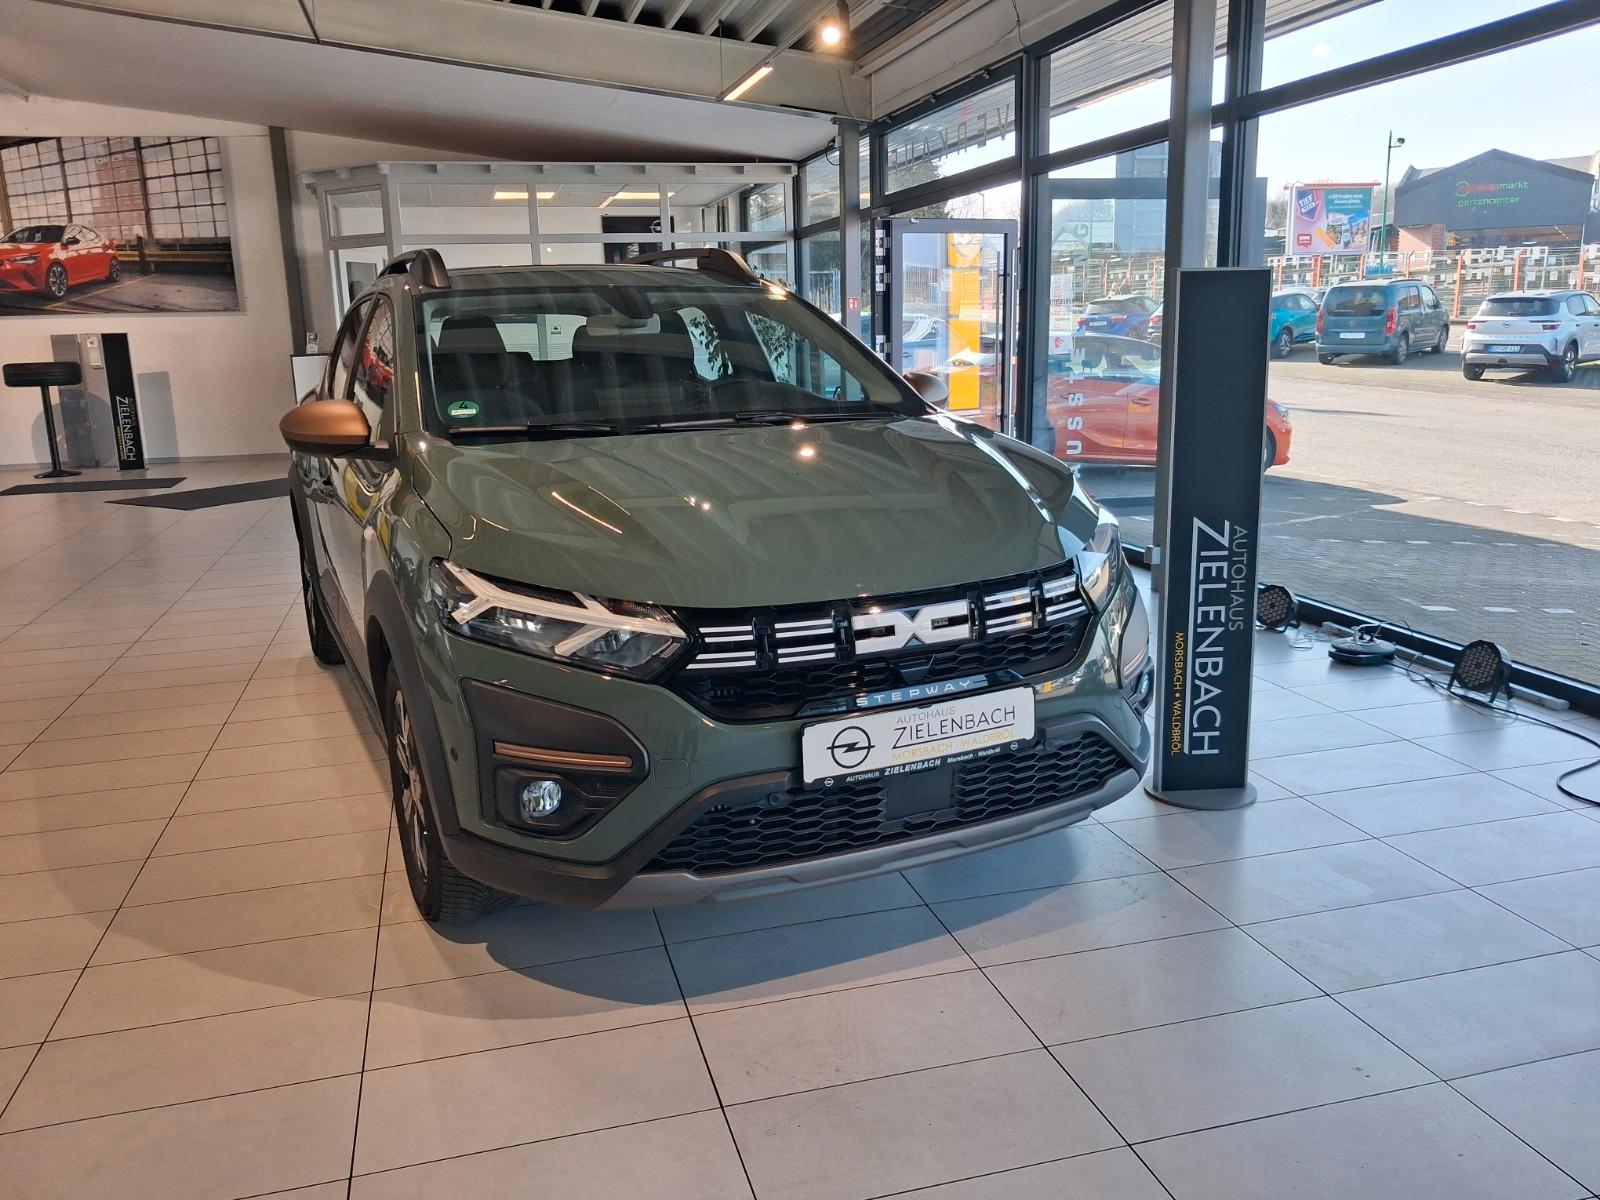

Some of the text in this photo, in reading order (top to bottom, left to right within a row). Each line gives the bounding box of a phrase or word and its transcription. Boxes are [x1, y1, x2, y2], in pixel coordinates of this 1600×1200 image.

[116, 395, 137, 461] ZIELENBACH
[1228, 525, 1248, 631] AUTOHAUS
[1188, 516, 1230, 755] ZIELENBACH
[856, 679, 972, 706] STEPWAY
[1171, 631, 1184, 756] MORSBACH WALDBRÖL
[892, 705, 1016, 749] ZIELENBACH
[896, 707, 956, 725] AUTOHAUS
[891, 730, 1015, 761] MORSBACH WALDBRÖL
[846, 771, 880, 783] AUTOHAUS
[884, 758, 941, 776] ZIELENBACH
[947, 753, 973, 764] Morsbach
